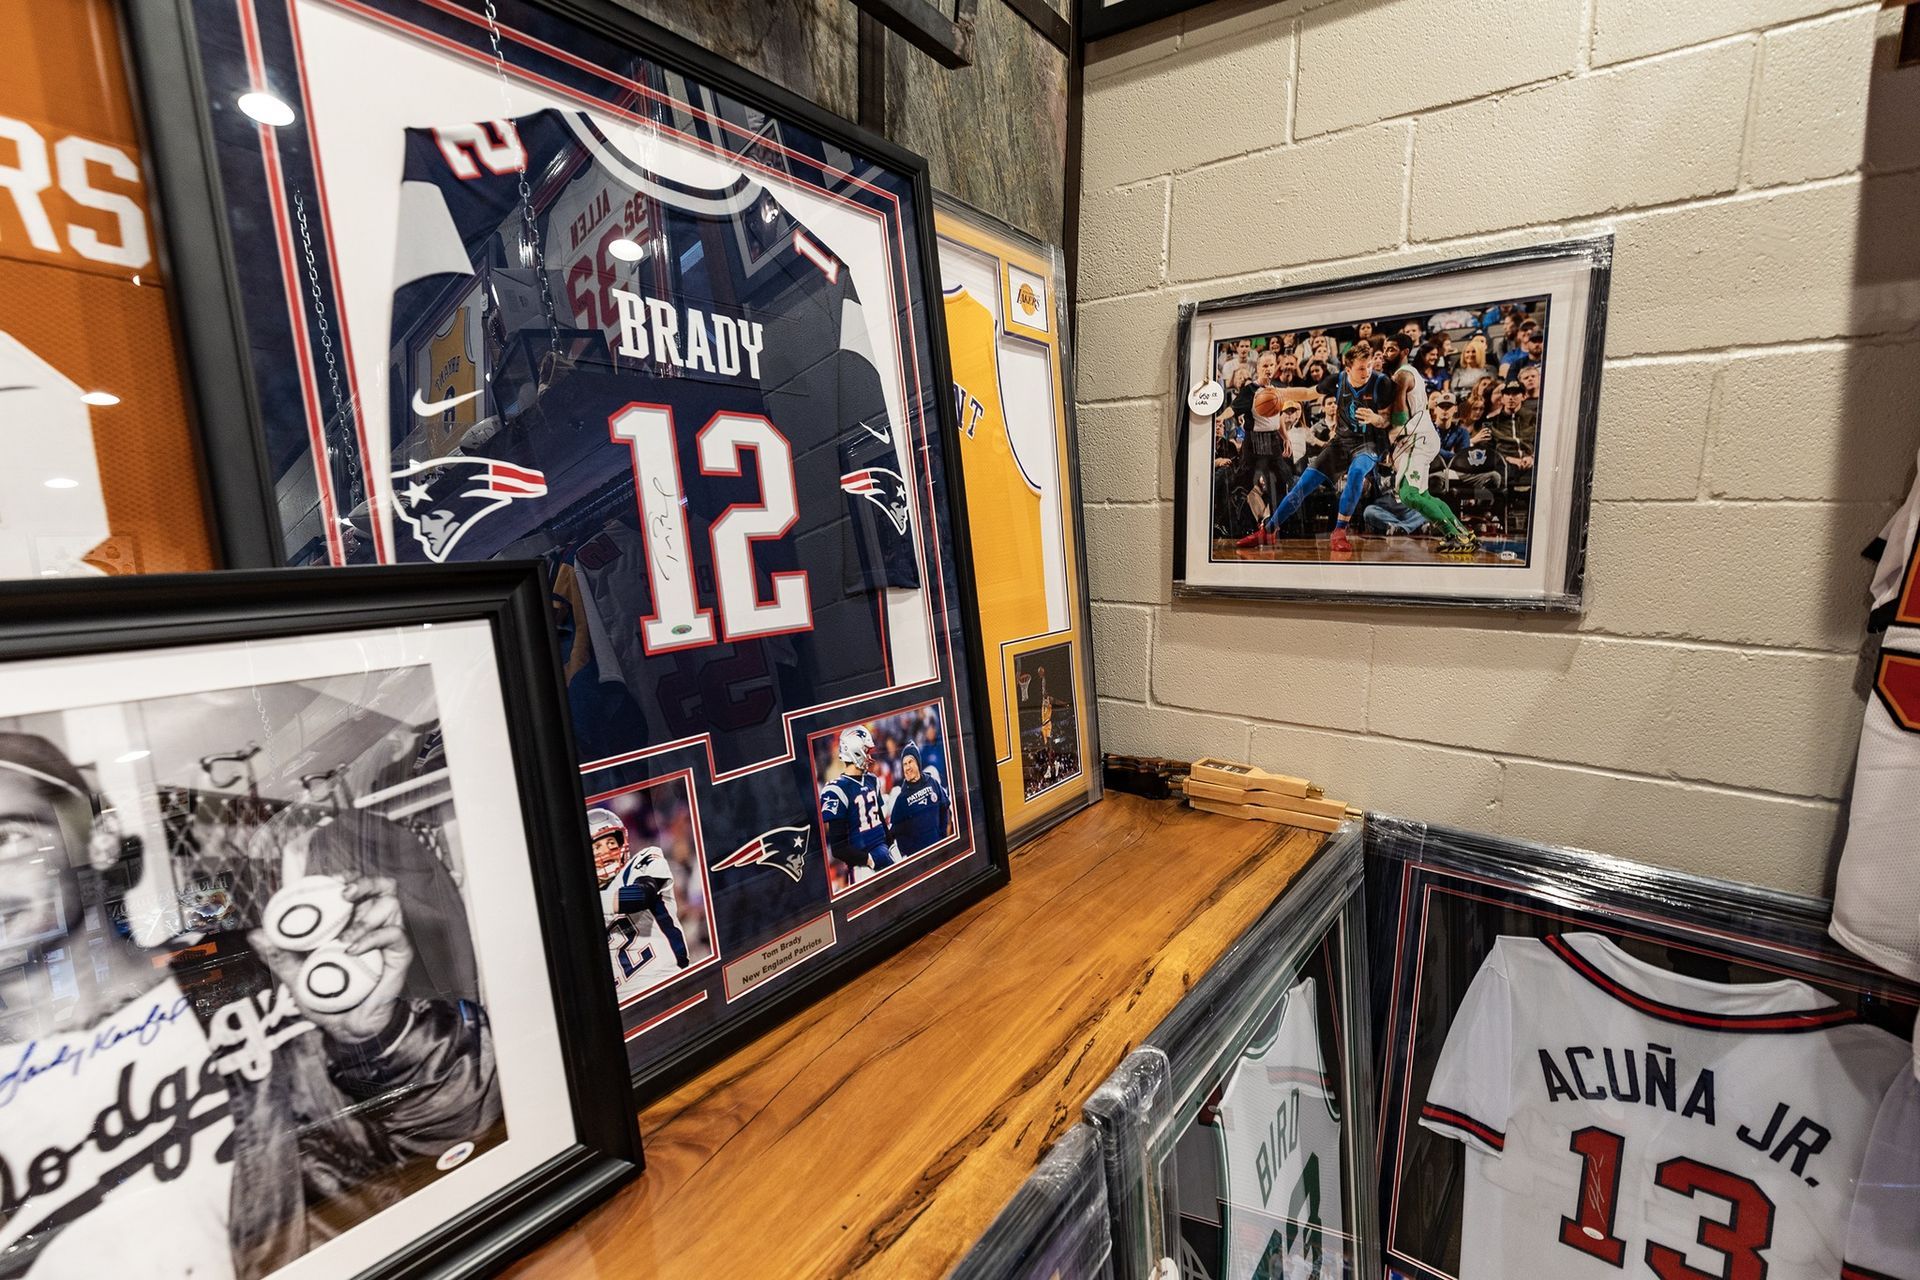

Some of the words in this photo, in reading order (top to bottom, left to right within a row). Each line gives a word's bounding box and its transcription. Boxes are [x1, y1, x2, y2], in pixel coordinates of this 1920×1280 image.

[793, 229, 840, 286] 1
[612, 288, 763, 380] BRADY
[608, 401, 814, 656] 12
[854, 790, 882, 832] 12
[741, 970, 760, 985] New
[762, 953, 793, 974] England
[794, 937, 822, 957] Patriots
[761, 947, 779, 960] Tom
[780, 935, 802, 952] Brady
[1256, 1088, 1299, 1209] BIRD
[1537, 1043, 1716, 1126] ACUÑA
[1736, 1102, 1831, 1188] JR.
[1559, 1125, 1776, 1280] 13
